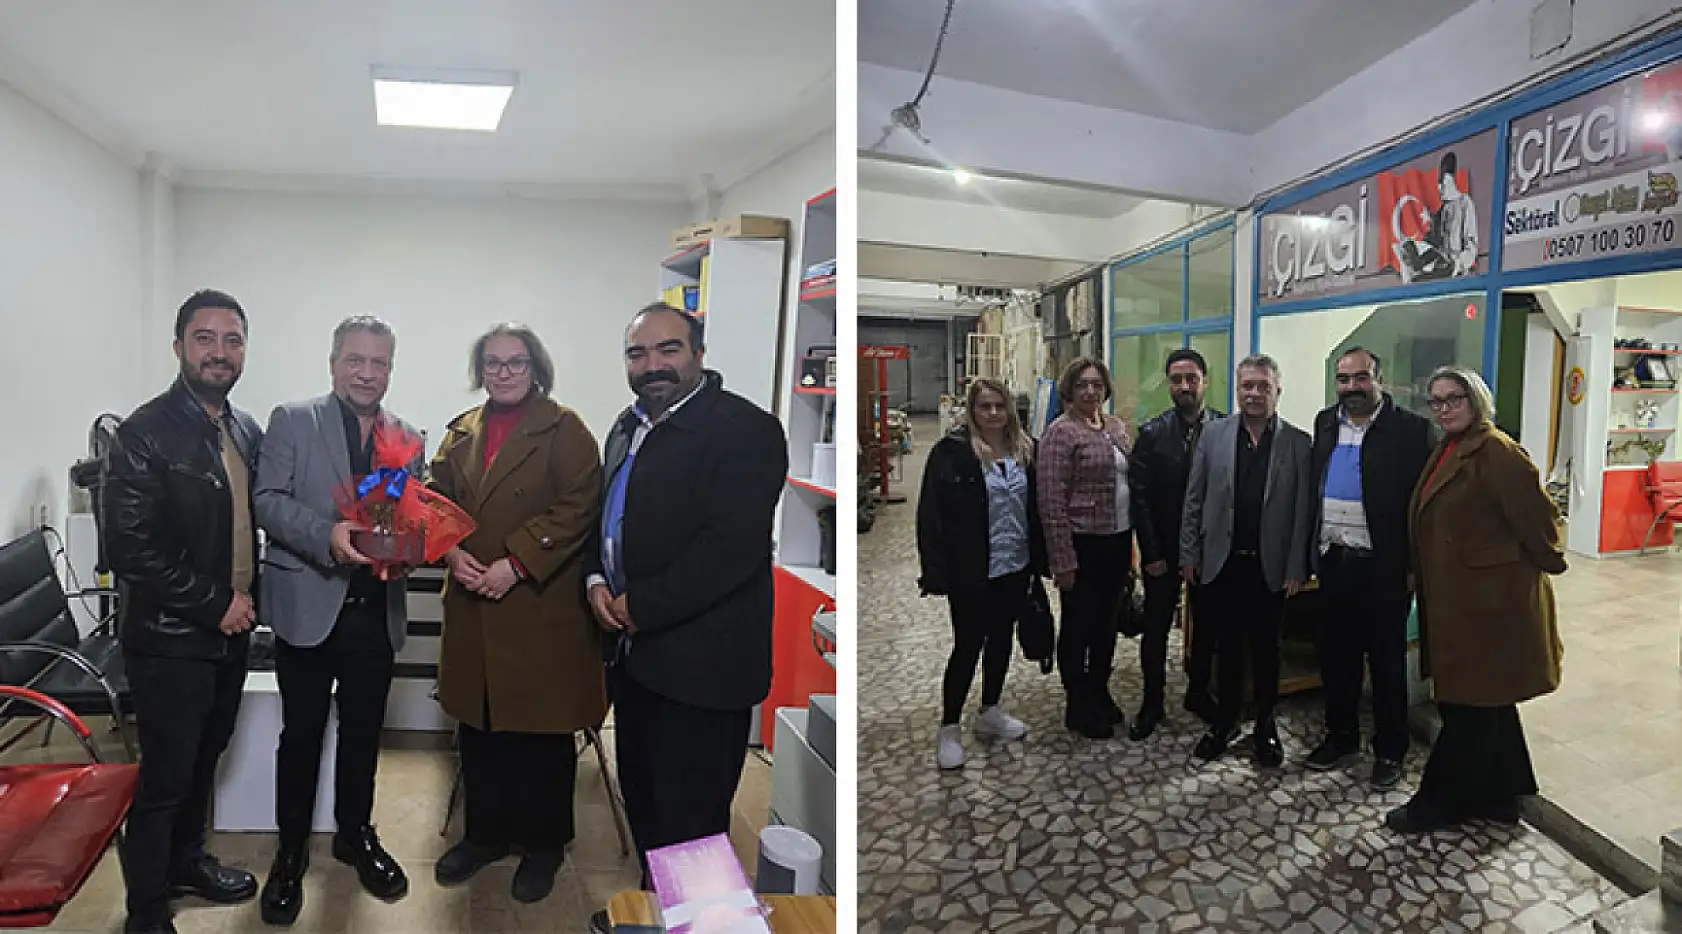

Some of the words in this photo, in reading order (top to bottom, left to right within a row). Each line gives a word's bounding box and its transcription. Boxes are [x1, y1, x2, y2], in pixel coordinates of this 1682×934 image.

[1517, 87, 1627, 195] ÇİZGİ
[1273, 184, 1367, 297] ÇİZGİ
[1550, 234, 1585, 258] 0507
[1591, 229, 1619, 252] 100
[1625, 224, 1646, 248] 30
[1651, 218, 1674, 245] 70
